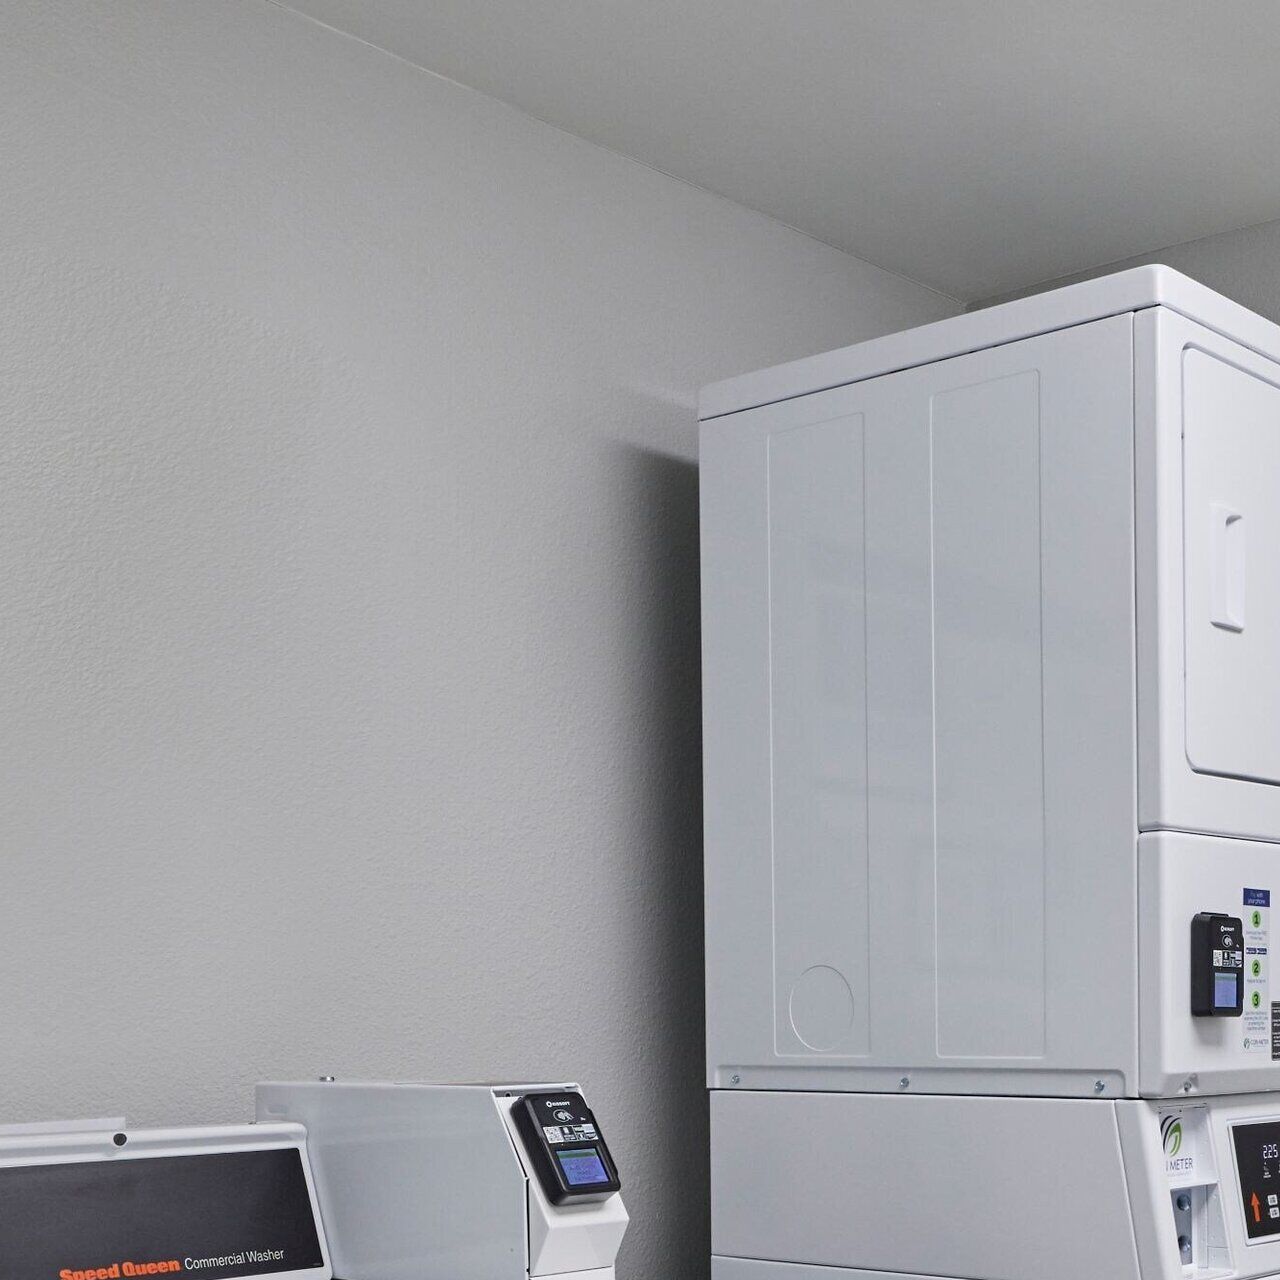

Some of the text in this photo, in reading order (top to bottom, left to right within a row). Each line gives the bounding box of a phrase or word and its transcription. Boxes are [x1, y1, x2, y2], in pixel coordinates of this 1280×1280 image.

[1262, 1143, 1279, 1159] 225
[122, 1258, 181, 1278] Queen
[184, 1252, 246, 1270] Commercial
[247, 1248, 285, 1264] Washer
